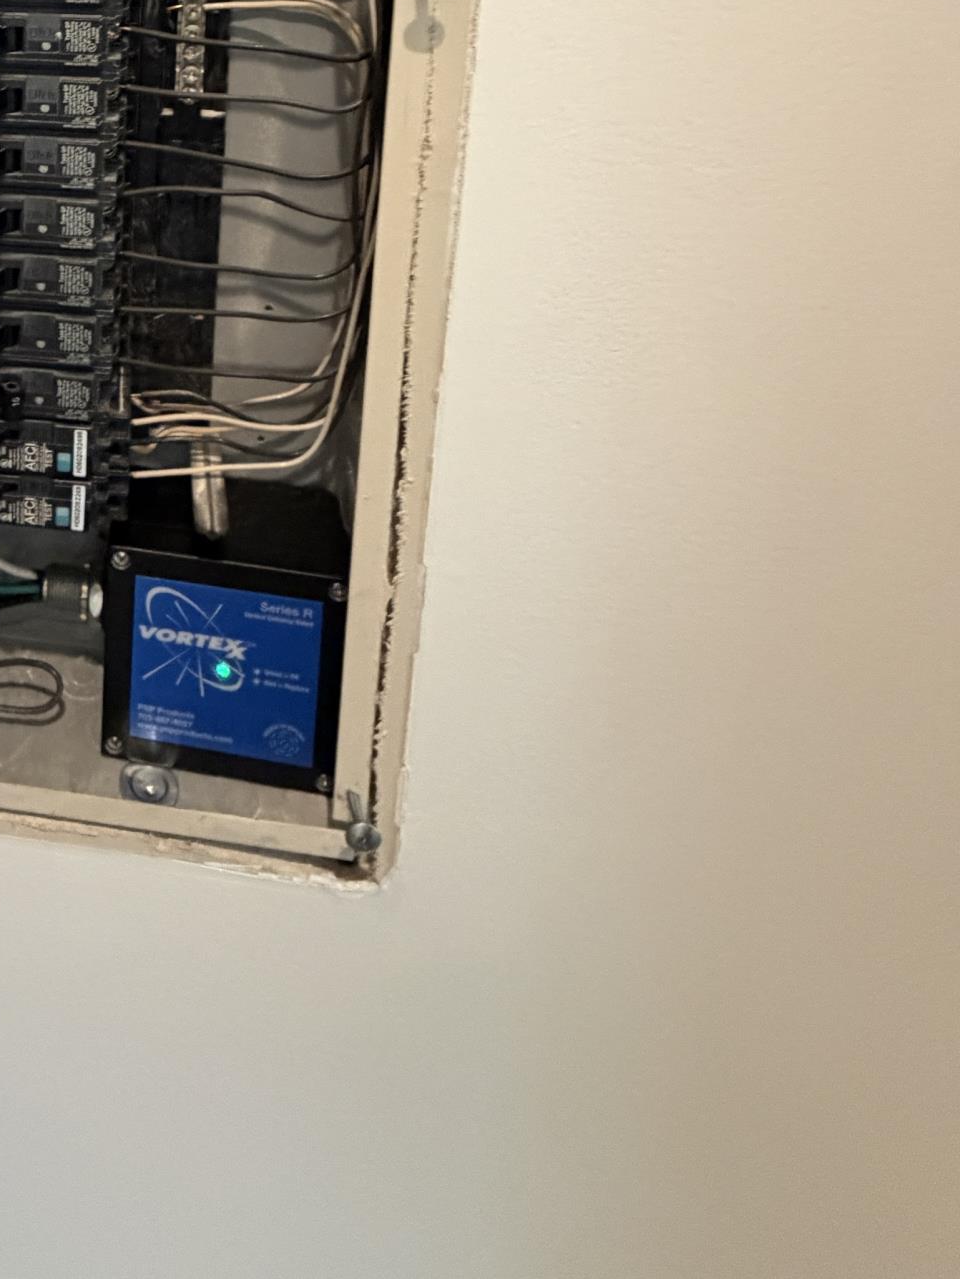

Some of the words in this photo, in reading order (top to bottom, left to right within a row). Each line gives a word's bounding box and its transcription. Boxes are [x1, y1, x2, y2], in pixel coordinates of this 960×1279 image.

[24, 443, 38, 470] AFCI
[44, 449, 53, 468] TEST
[24, 497, 38, 524] AFCI
[43, 503, 52, 522] TEST
[259, 601, 300, 618] Series
[302, 608, 313, 619] R
